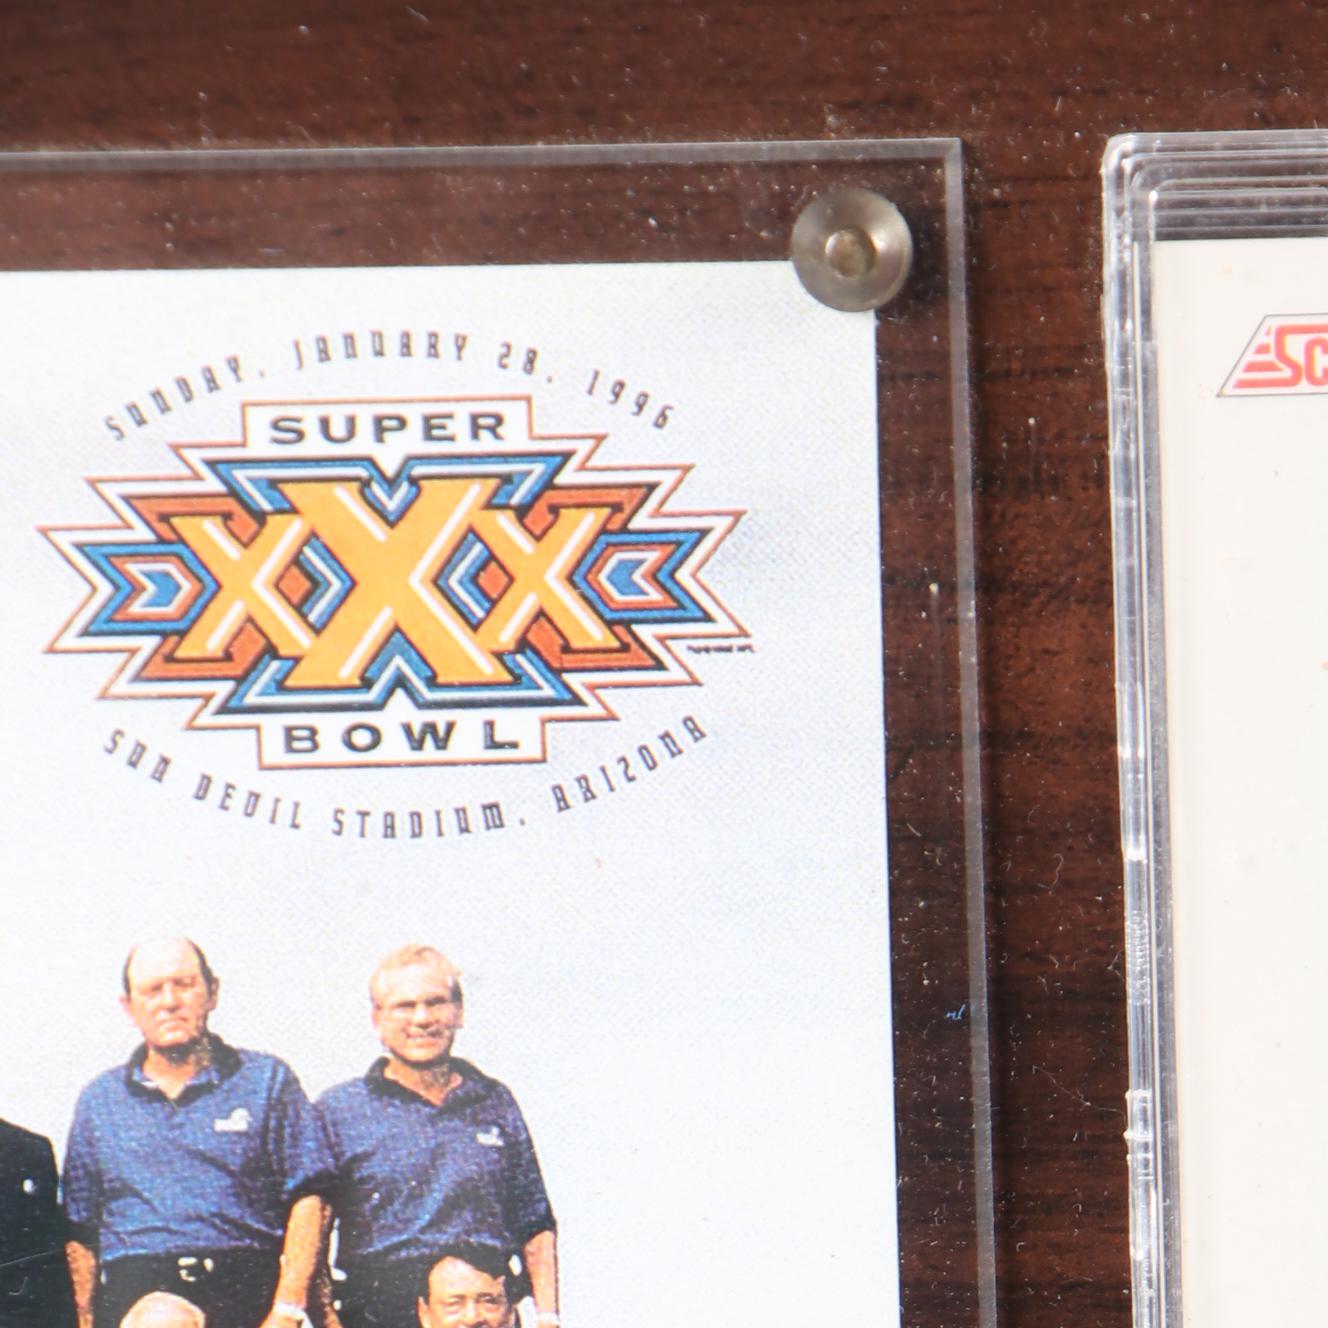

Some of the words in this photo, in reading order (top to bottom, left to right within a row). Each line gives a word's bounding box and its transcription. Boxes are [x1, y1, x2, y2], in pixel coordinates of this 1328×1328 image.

[269, 412, 505, 445] SUPER
[293, 329, 468, 371] JANUARY
[585, 369, 675, 430] 1996
[166, 478, 623, 688] XXX
[103, 728, 172, 783] SUN
[192, 772, 302, 830] DEVIL
[551, 714, 707, 813] ARIZONA
[283, 719, 520, 754] BOWL
